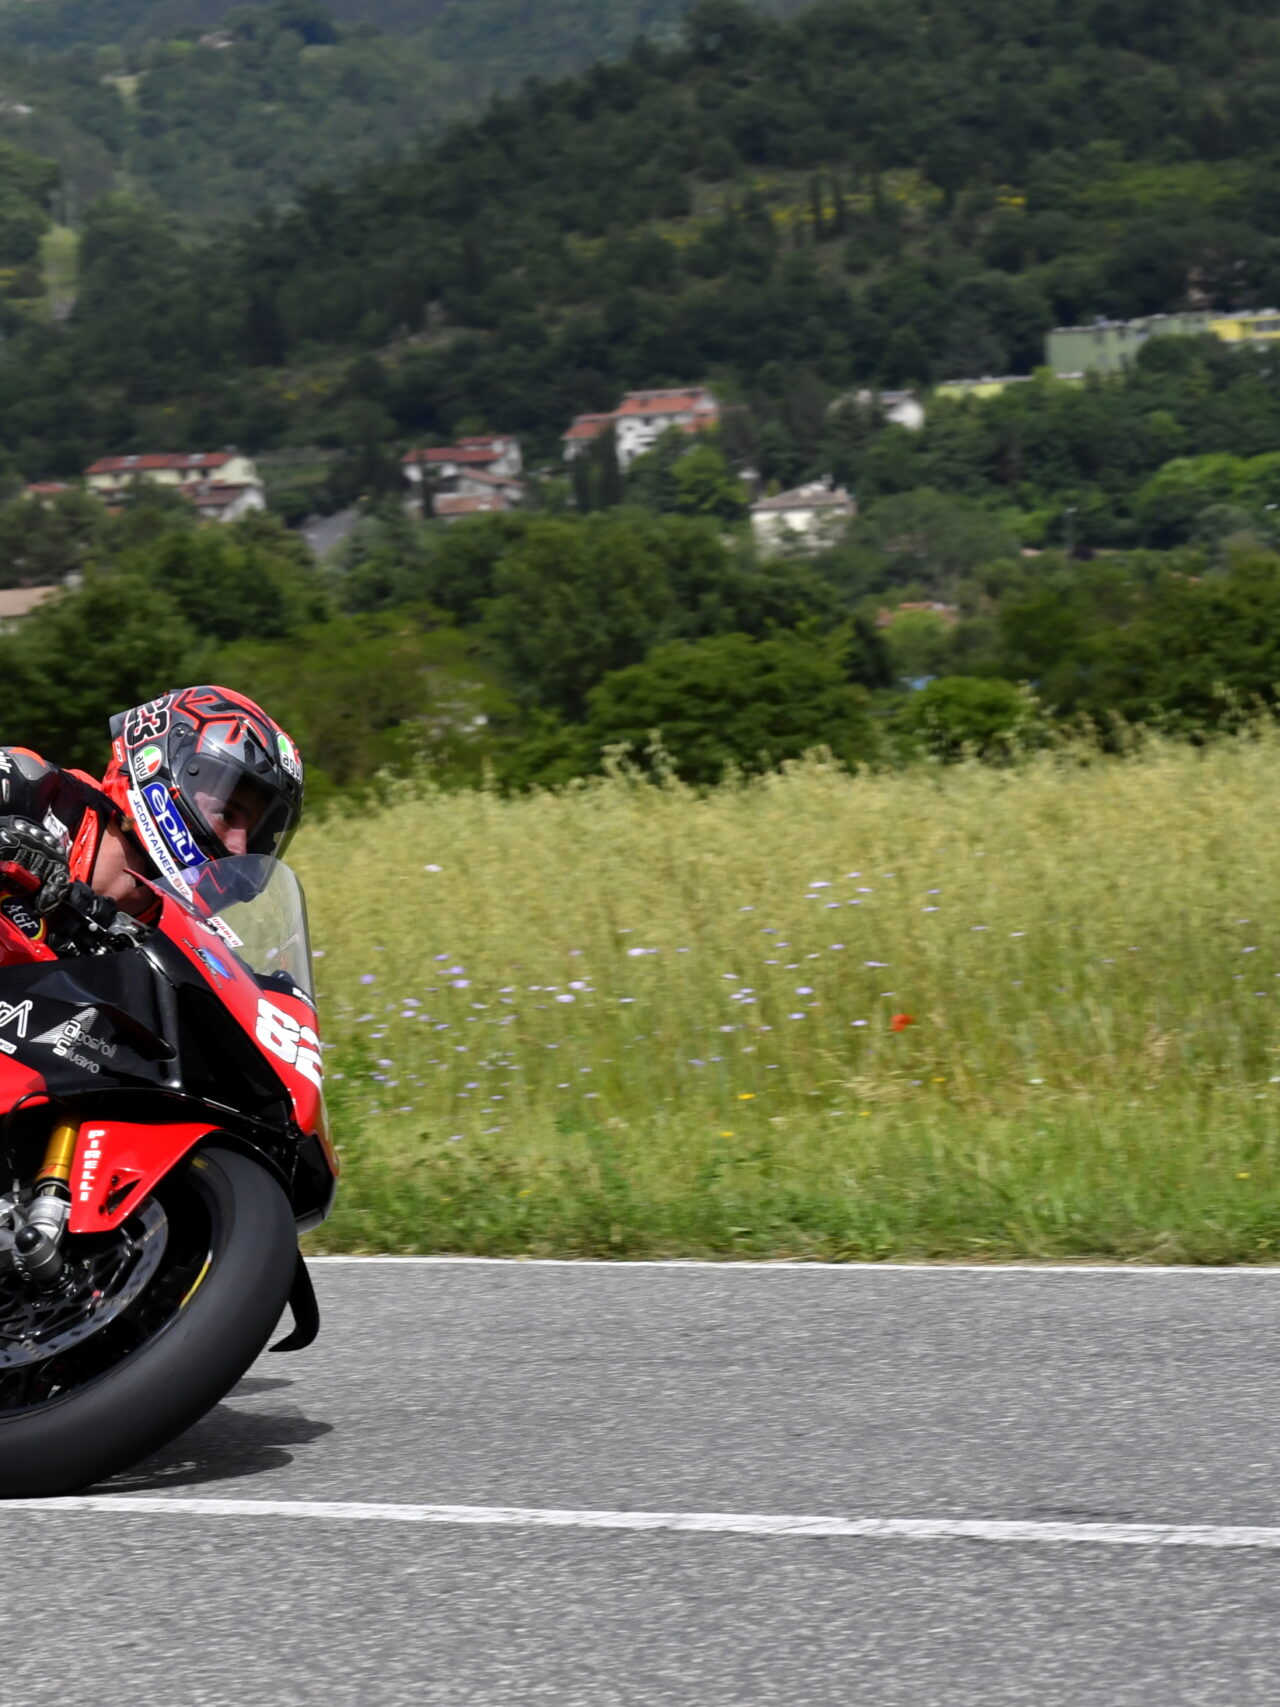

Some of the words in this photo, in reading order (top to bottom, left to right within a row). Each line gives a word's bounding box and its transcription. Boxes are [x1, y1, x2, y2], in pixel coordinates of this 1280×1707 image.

[135, 755, 148, 779] agv
[2, 902, 40, 933] AGF
[80, 1129, 106, 1202] PIRELLI
